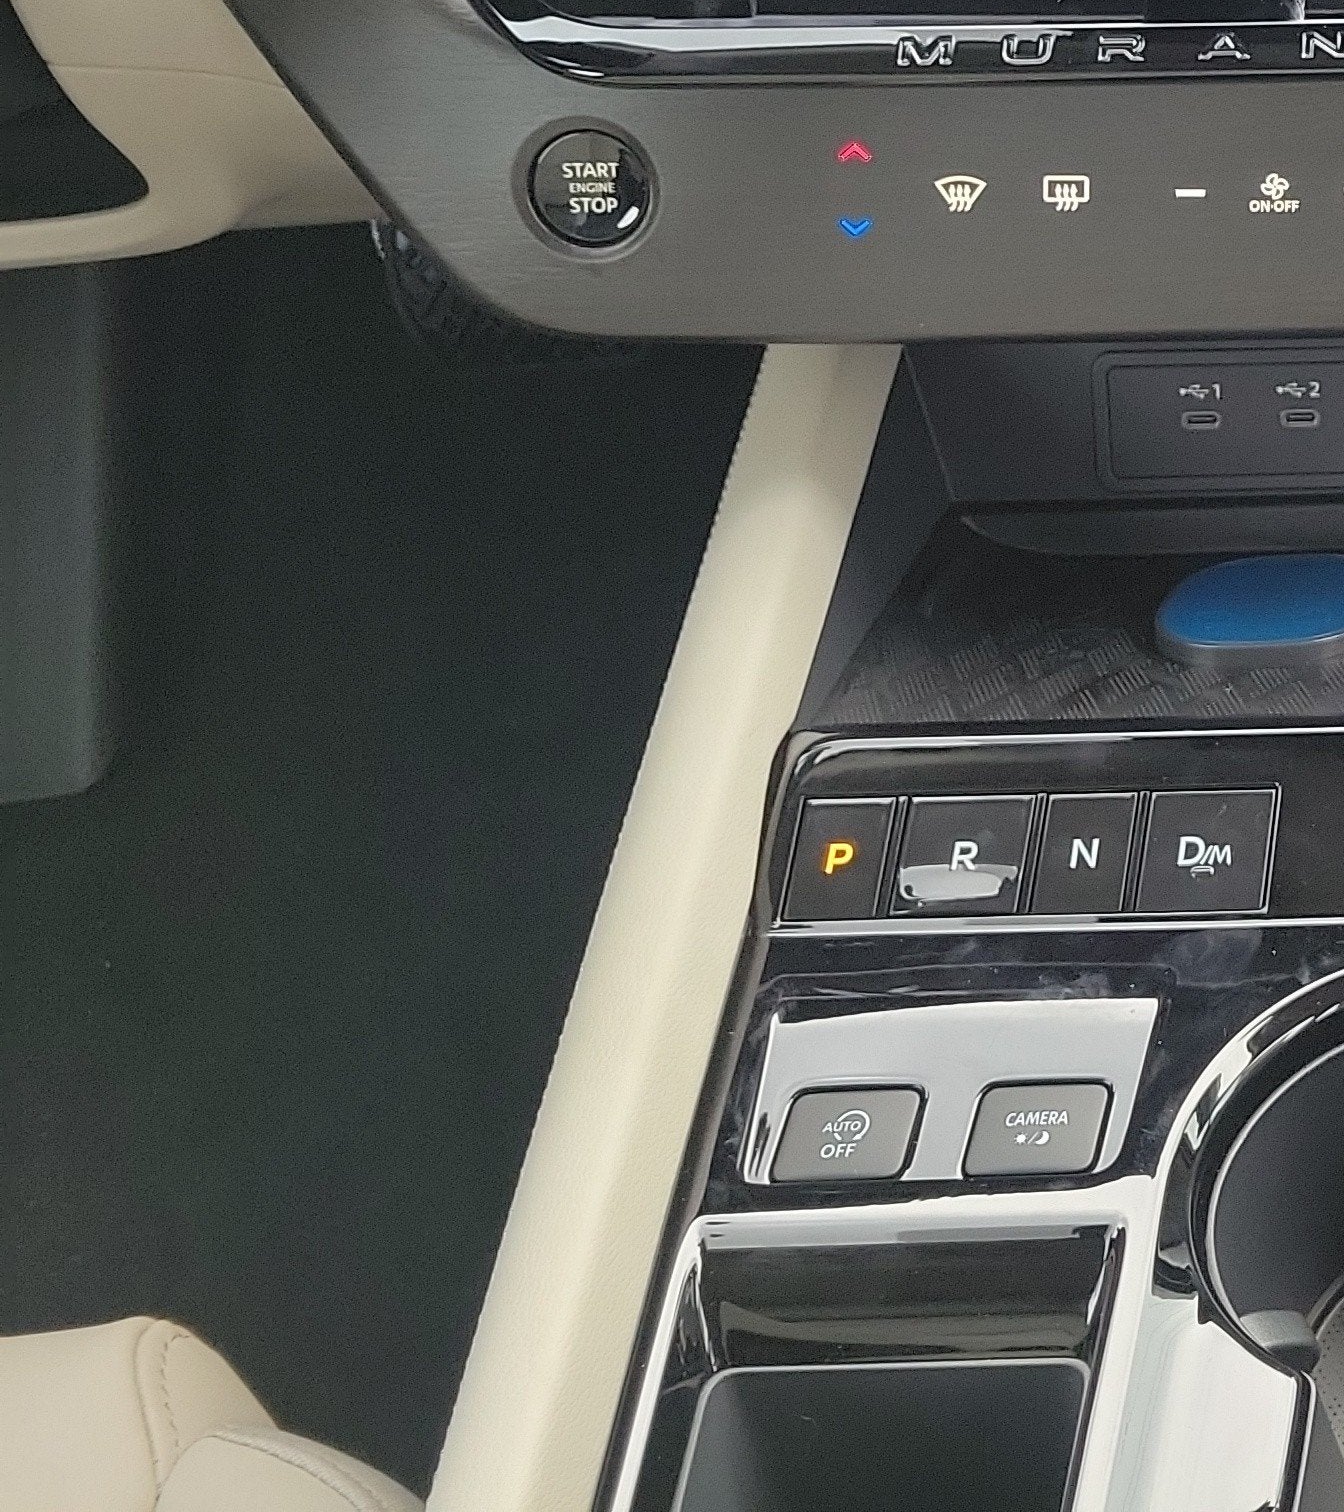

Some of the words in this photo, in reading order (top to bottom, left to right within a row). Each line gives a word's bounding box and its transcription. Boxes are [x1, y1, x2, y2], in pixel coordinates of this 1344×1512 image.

[562, 161, 619, 179] START
[569, 182, 616, 194] ENGINE
[569, 197, 618, 214] STOP
[1213, 383, 1222, 399] 1
[1309, 382, 1321, 398] 2
[824, 843, 855, 875] P
[949, 840, 978, 870] R
[1069, 838, 1100, 869] N
[822, 1120, 863, 1134] AUTO
[1006, 1110, 1069, 1127] CAMERA
[820, 1143, 857, 1159] OFF
